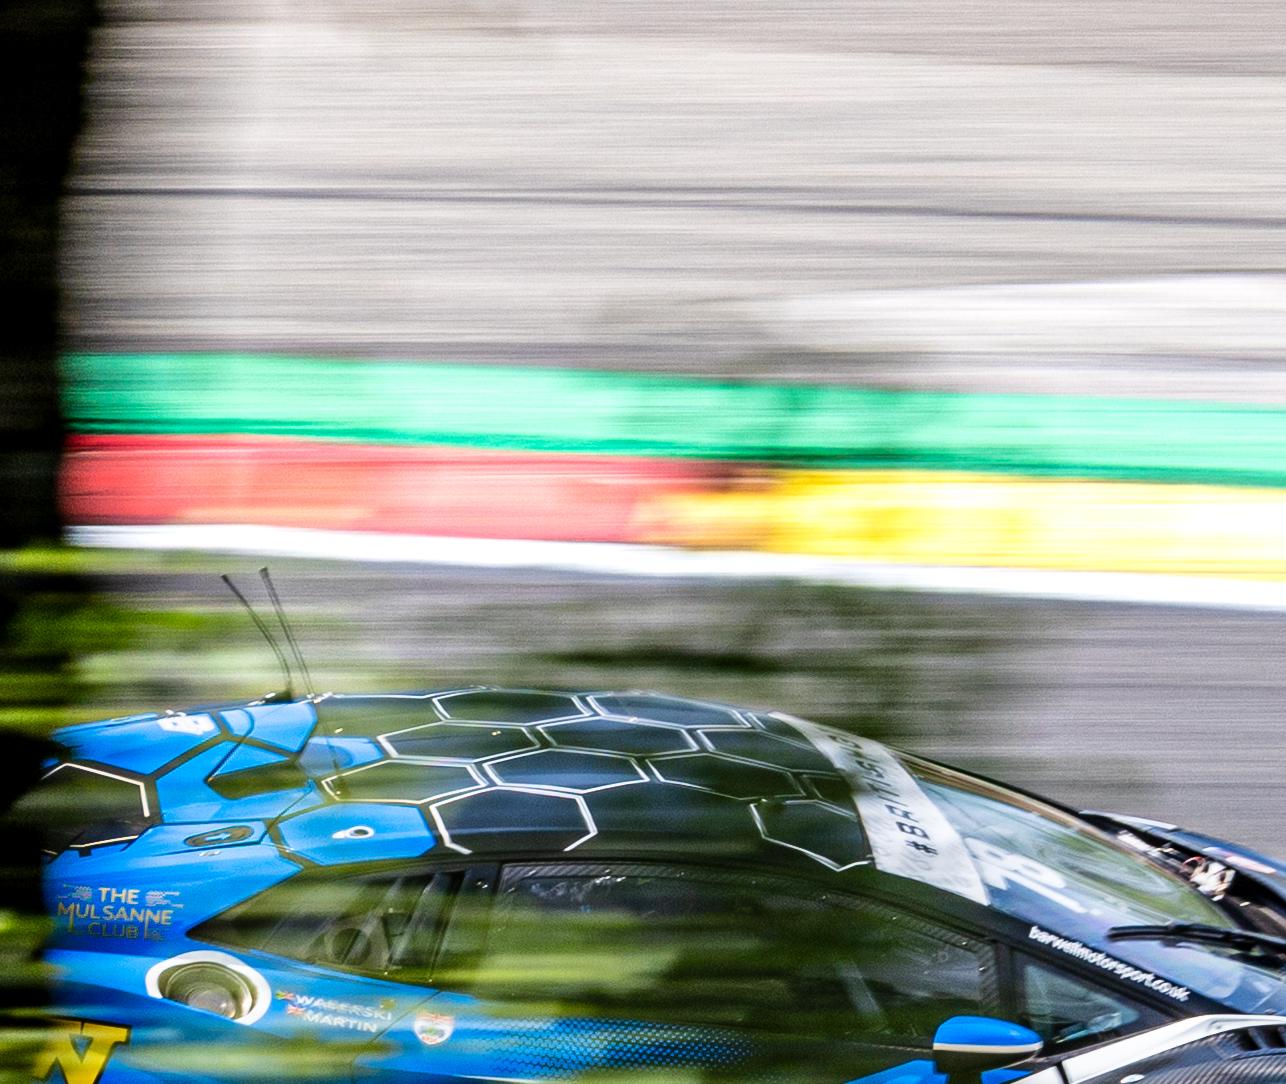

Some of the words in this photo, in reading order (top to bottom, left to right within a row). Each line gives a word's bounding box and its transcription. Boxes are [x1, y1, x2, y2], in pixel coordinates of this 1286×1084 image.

[98, 887, 141, 905] THE
[57, 902, 174, 932] MULSANNE
[88, 922, 139, 939] CLUB
[303, 1010, 378, 1033] MARTIN
